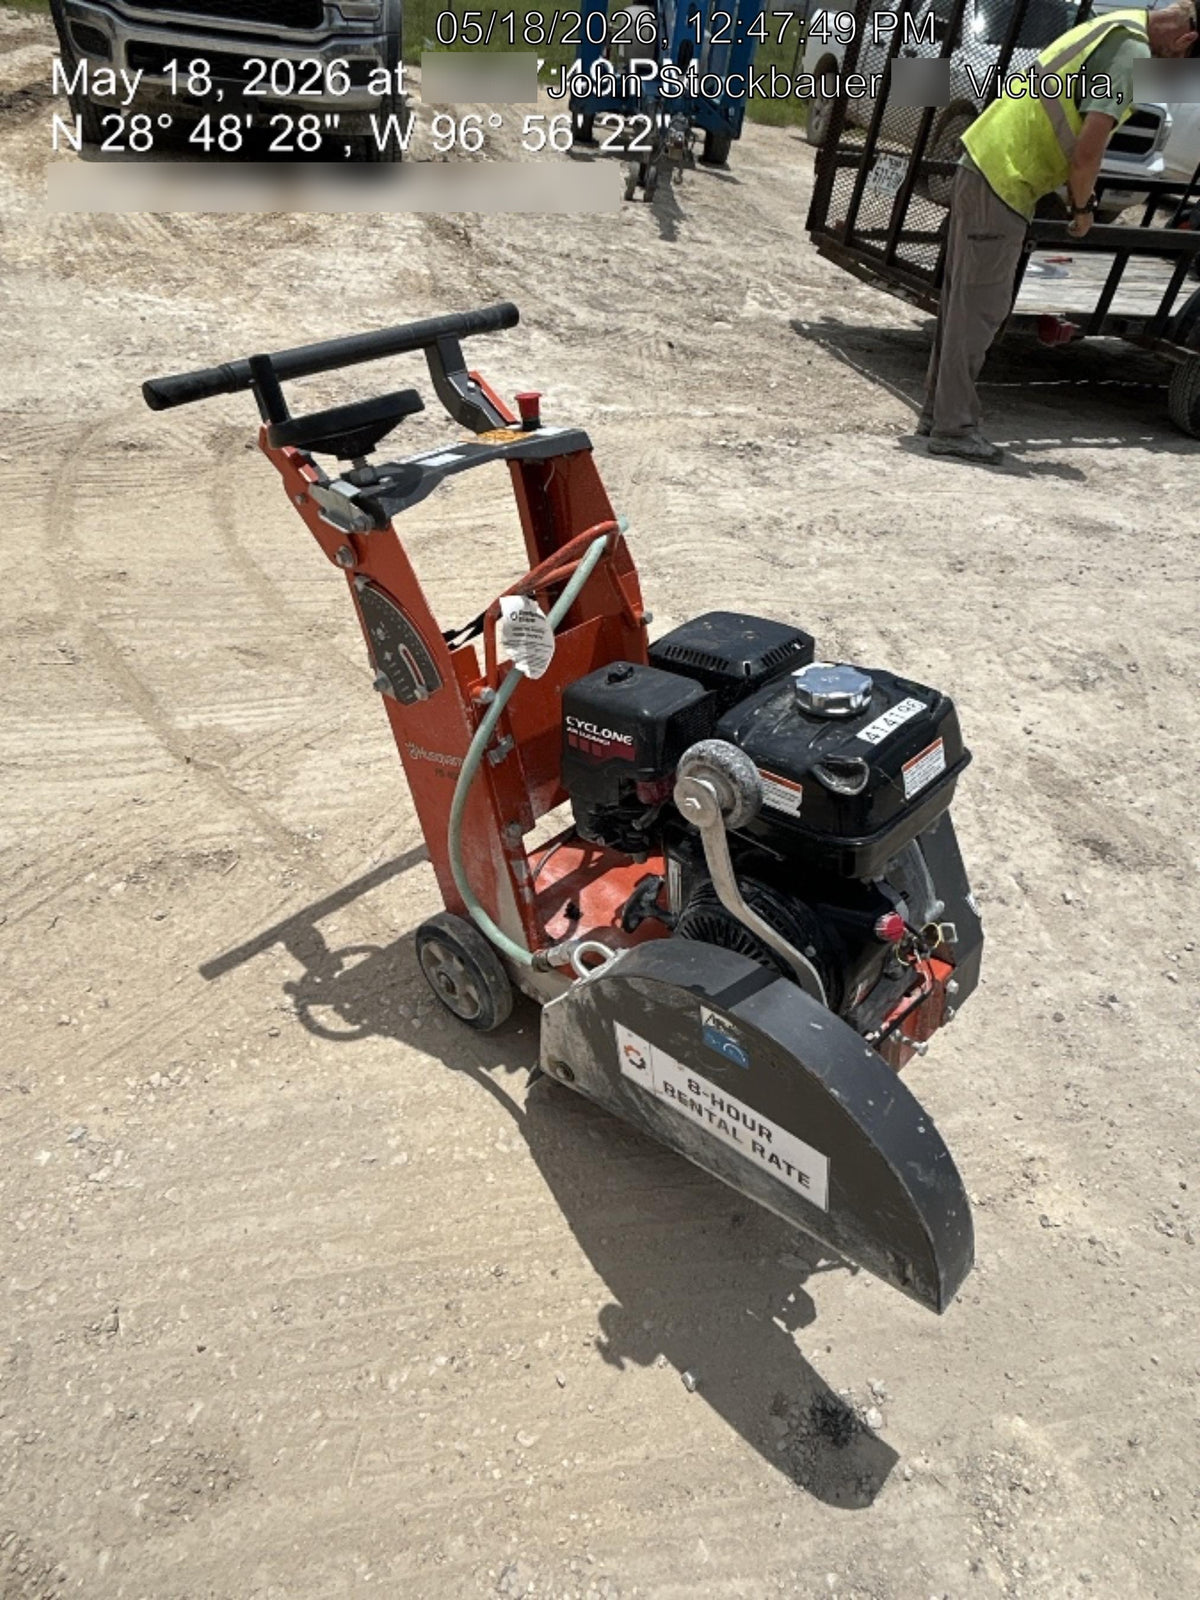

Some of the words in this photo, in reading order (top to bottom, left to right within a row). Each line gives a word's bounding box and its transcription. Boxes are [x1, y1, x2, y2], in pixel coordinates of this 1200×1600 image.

[565, 715, 633, 746] CYCLONE
[662, 1080, 743, 1143] RENTAL
[751, 1139, 811, 1190] RATE
[687, 1077, 773, 1143] 8-HOUR
